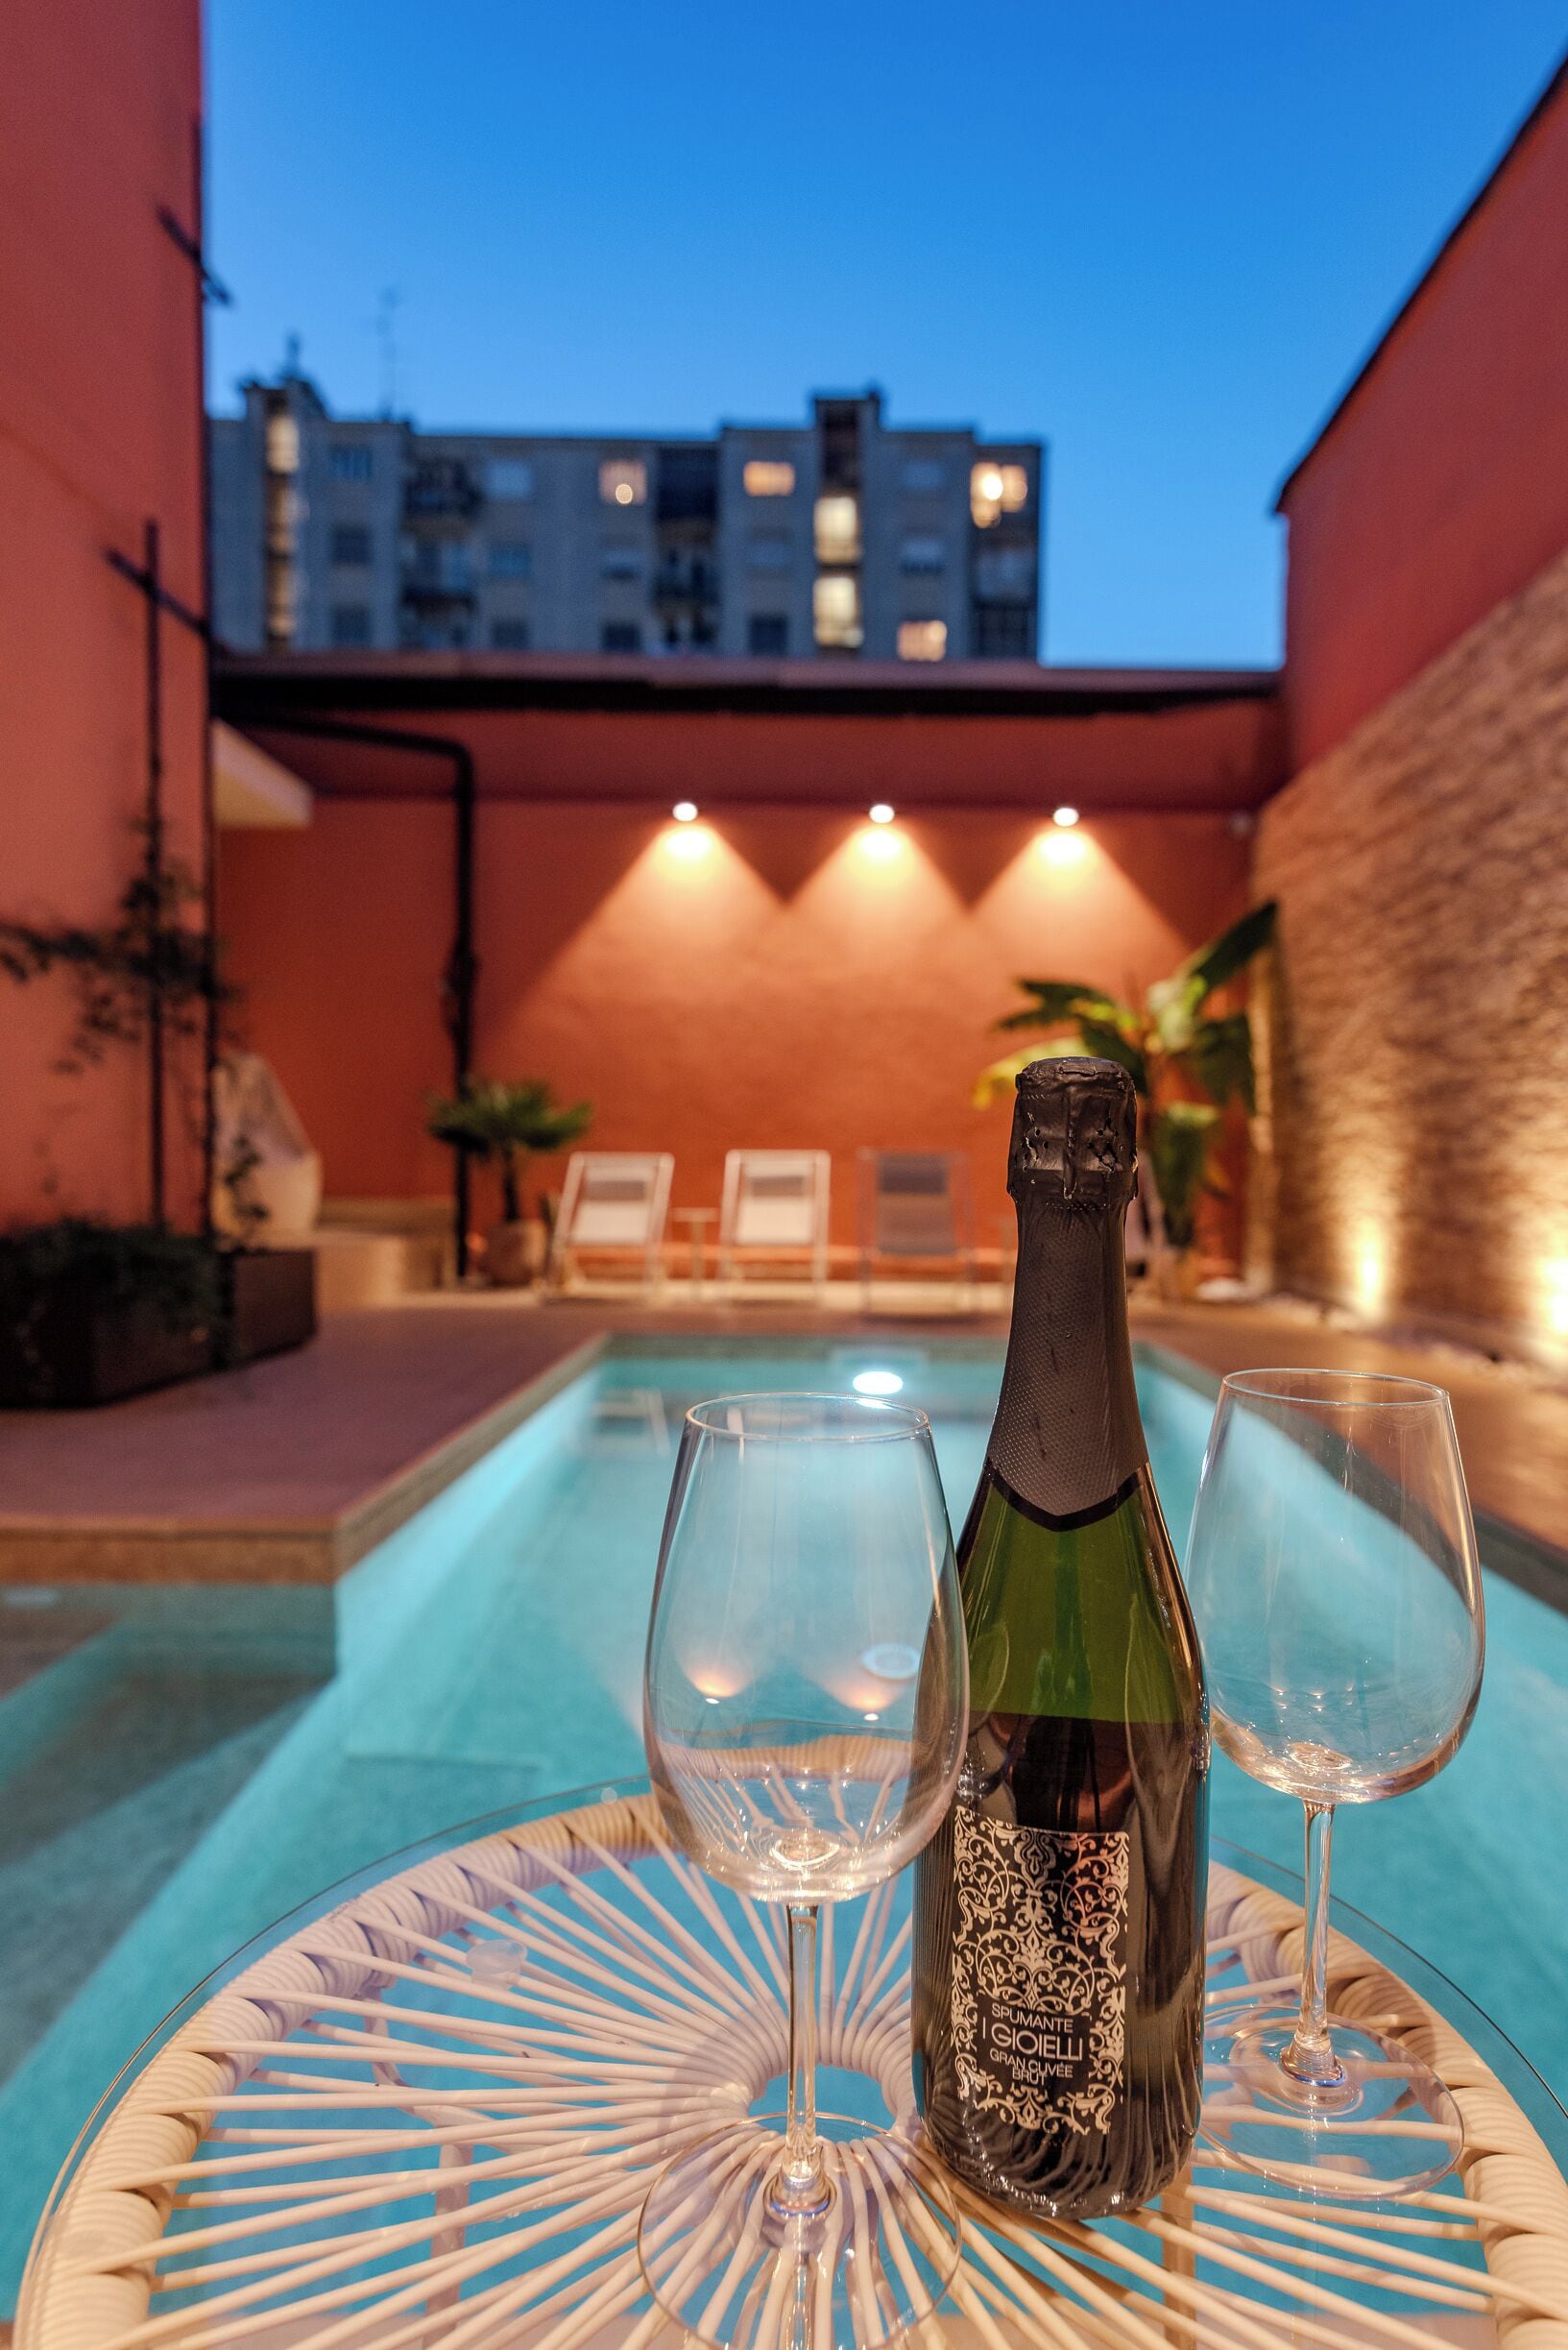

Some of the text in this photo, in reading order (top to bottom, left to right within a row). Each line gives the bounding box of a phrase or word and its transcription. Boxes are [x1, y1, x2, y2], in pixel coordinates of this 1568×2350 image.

[991, 2003, 1073, 2033] SPUMANTE
[991, 2023, 1083, 2062] GIOIELLI
[989, 2048, 1073, 2079] GRAN CUVÉE
[1012, 2069, 1047, 2086] BRUT
